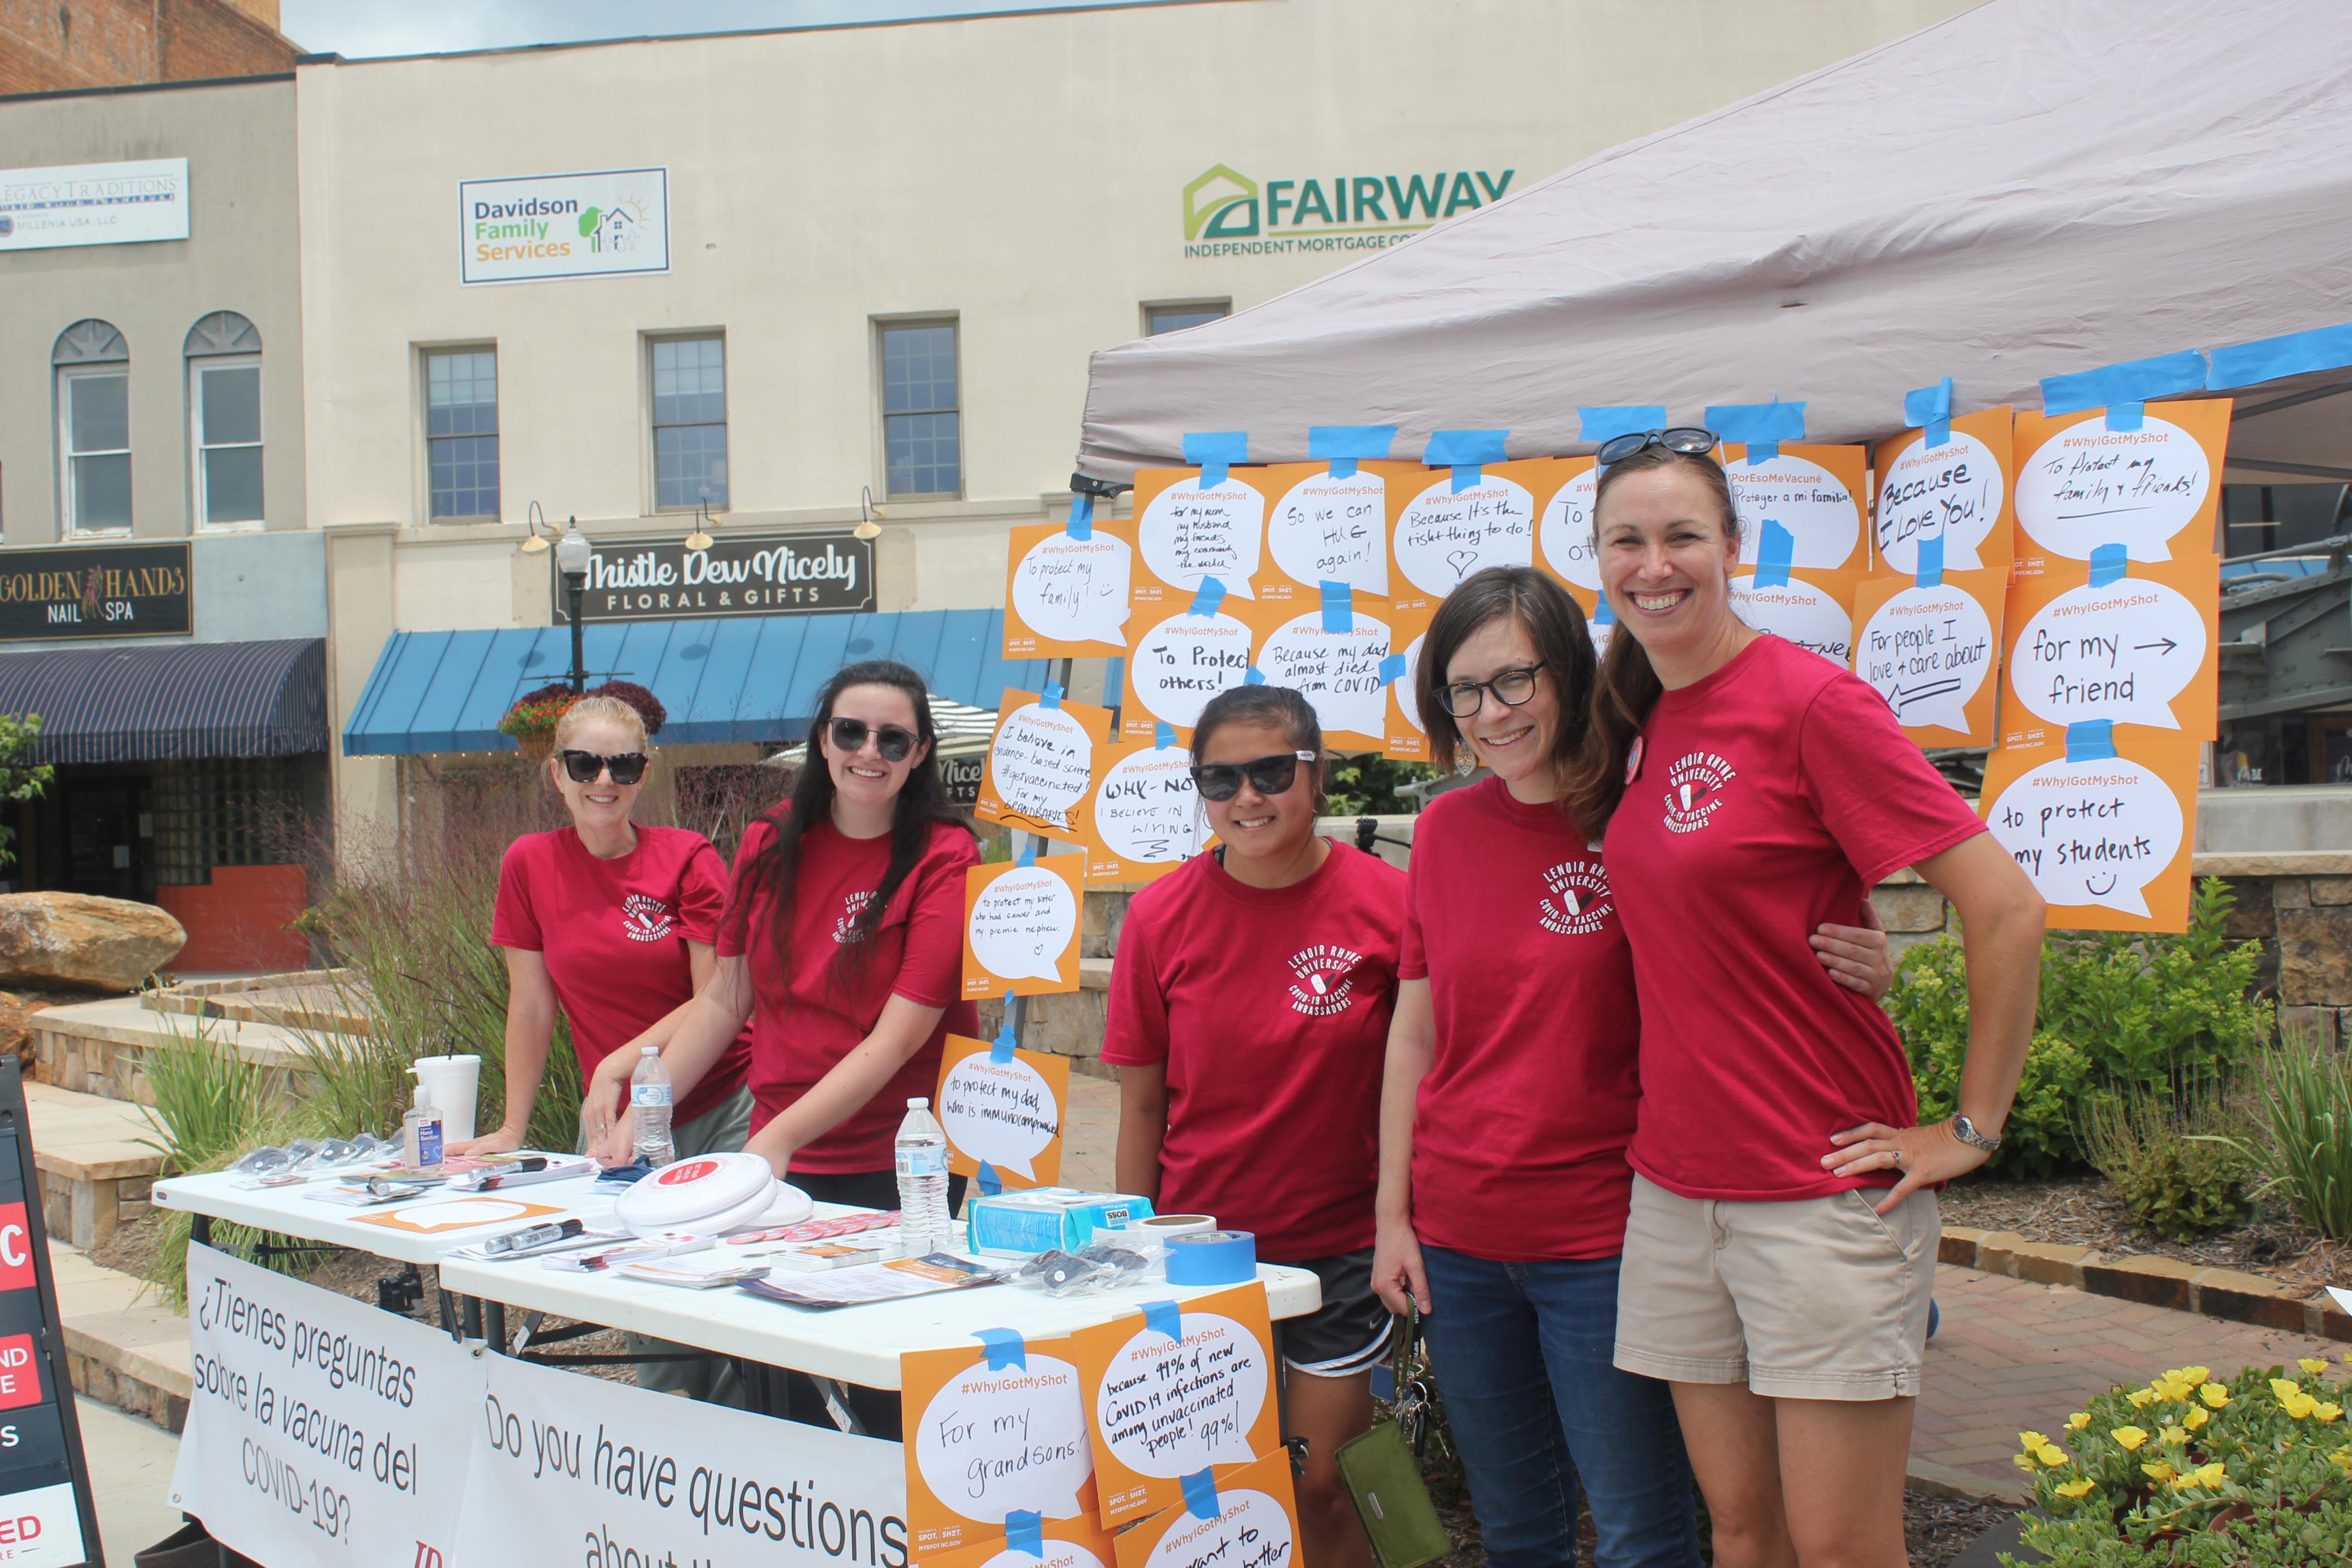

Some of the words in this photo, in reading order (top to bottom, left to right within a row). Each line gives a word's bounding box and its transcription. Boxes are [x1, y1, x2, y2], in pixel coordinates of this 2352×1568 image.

[0, 186, 61, 202] EGACY
[65, 178, 176, 198] TRADITIONS
[1267, 169, 1515, 226] FAIRWAY
[476, 198, 578, 218] Davidson
[97, 215, 117, 225] LLC
[476, 218, 549, 240] Family
[476, 241, 570, 262] Services
[1185, 240, 1294, 257] INDEPENDENT
[1298, 235, 1385, 252] MORTGAGE
[2063, 433, 2168, 448] #WhyIGotMyShot
[1900, 445, 1969, 471] #WhyIGotMyShot
[2042, 456, 2065, 475] To
[1729, 474, 1822, 483] PorEsoMeVacuné
[1884, 463, 1972, 515] Because
[1171, 492, 1247, 501] #WhyIGotMyShot
[1303, 487, 1383, 496] #WhyIGotMyShot
[1426, 489, 1509, 506] #WhyIGotMyShot
[1733, 485, 1778, 510] Proteger
[1783, 493, 1789, 502] a
[1795, 491, 1807, 502] mi
[1812, 489, 1852, 503] familia!
[2053, 479, 2108, 505] family
[1288, 507, 1305, 525] So
[1410, 512, 1463, 527] Because
[1494, 500, 1522, 516] the
[1177, 523, 1188, 535] my
[1324, 525, 1367, 546] HUG
[1408, 528, 1443, 546] right
[1444, 526, 1481, 545] thing
[1484, 522, 1501, 536] to
[1880, 520, 1893, 552] I
[1043, 544, 1115, 555] #WhyIGotMyShot
[1316, 541, 1371, 574] again!
[586, 551, 677, 591] Thistle
[683, 550, 751, 585] Dew
[752, 544, 856, 591] Nicely
[1026, 555, 1037, 575] To
[1039, 559, 1073, 582] protect
[1077, 563, 1092, 585] my
[0, 571, 82, 602] GOLDEN
[105, 566, 184, 598] HANDS
[608, 591, 706, 610] FLORAL
[720, 592, 732, 606] &
[745, 587, 819, 604] GIFTS
[1890, 601, 1963, 617] #WhyIGotMyShot
[2053, 593, 2158, 618] #WhyIGotMyShot
[48, 604, 82, 623] NAIL
[105, 602, 133, 621] SPA
[1165, 627, 1238, 637] #WhyIGotMyShot
[1872, 630, 1891, 652] For
[1895, 624, 1934, 657] people
[1943, 619, 1957, 640] I
[1152, 646, 1175, 665] To
[1193, 646, 1250, 670] Protect
[1273, 647, 1329, 664] Because
[1338, 647, 1356, 663] my
[1362, 641, 1388, 657] dad
[2033, 629, 2071, 662] for
[2080, 634, 2119, 668] my
[1286, 662, 1329, 677] almost
[1334, 660, 1375, 676] died
[1869, 662, 1892, 683] love
[1910, 653, 1940, 674] care
[1946, 637, 1987, 670] about
[1160, 671, 1222, 692] others!
[1296, 678, 1327, 693] from
[1334, 676, 1381, 694] COVID
[2048, 672, 2134, 704] friend
[1018, 715, 1073, 734] #WhyIGotMyShot
[1003, 726, 1014, 738] I
[1061, 745, 1075, 759] in
[1669, 752, 1704, 775] LENOIR
[1706, 753, 1736, 782] RHYNE
[1670, 768, 1723, 791] UNIVERSITY
[2032, 775, 2138, 788] #WhyIGotMyShot
[1033, 794, 1047, 806] my
[1169, 805, 1181, 817] IN
[1686, 798, 1723, 822] VACCINE
[2002, 806, 2024, 828] to
[2040, 798, 2125, 838] protect
[2014, 849, 2042, 876] my
[2058, 836, 2151, 865] students
[1543, 862, 1584, 883] LENOIR
[994, 880, 1052, 893] #WhyIGotMyShot
[1550, 875, 1612, 894] UNIVERSITY
[983, 897, 990, 907] to
[994, 897, 1022, 910] protect
[1025, 898, 1034, 910] my
[990, 912, 1001, 920] had
[1035, 907, 1051, 916] and
[1540, 898, 1571, 924] COVID-19
[1575, 904, 1613, 925] VACCINE
[975, 927, 983, 939] my
[1539, 917, 1603, 934] AMBASSADORS
[1288, 945, 1324, 968] LENOIR
[1330, 945, 1362, 964] RHYNE
[1296, 958, 1352, 979] UNIVERSITY
[1289, 985, 1320, 1005] COVID-19
[1324, 979, 1353, 1004] VACCINE
[1292, 997, 1352, 1015] AMBASSADORS
[968, 1063, 1031, 1082] #WhyIGotMyShot
[951, 1076, 960, 1091] to
[963, 1080, 998, 1097] protect
[1002, 1088, 1018, 1109] my
[947, 1101, 964, 1114] who
[968, 1102, 976, 1117] is
[1107, 1211, 1127, 1219] BOSS
[200, 1277, 286, 1351] ¿Tienes
[293, 1320, 416, 1407] preguntas
[1131, 1327, 1225, 1362] #WhyIGotMyShot
[1107, 1373, 1149, 1396] because
[1156, 1354, 1185, 1381] 99%
[1190, 1348, 1202, 1373] of
[1209, 1342, 1235, 1363] new
[962, 1374, 1068, 1394] #WhyIGotMyShot
[1167, 1369, 1225, 1403] infections
[1231, 1358, 1252, 1373] are
[1112, 1422, 1147, 1445] among
[1152, 1378, 1234, 1432] unvaccinated
[195, 1353, 247, 1411] sobre
[255, 1372, 274, 1425] la
[283, 1395, 364, 1472] vacuna
[374, 1433, 416, 1495] del
[941, 1411, 975, 1447] For
[994, 1407, 1030, 1441] my
[243, 1437, 351, 1545] COVID-19?
[486, 1394, 523, 1458] Do
[532, 1420, 581, 1479] you
[595, 1424, 677, 1507] have
[689, 1479, 908, 1566] questions
[1109, 1495, 1126, 1506] SPOT.
[1111, 1498, 1147, 1515] MYSPOT.NC.GOV
[918, 1533, 938, 1541] SPOT.
[1164, 1500, 1250, 1554] #WhyIGotMyShot
[1239, 1525, 1258, 1546] to
[918, 1540, 961, 1551] MYSPOT.NC.GOV
